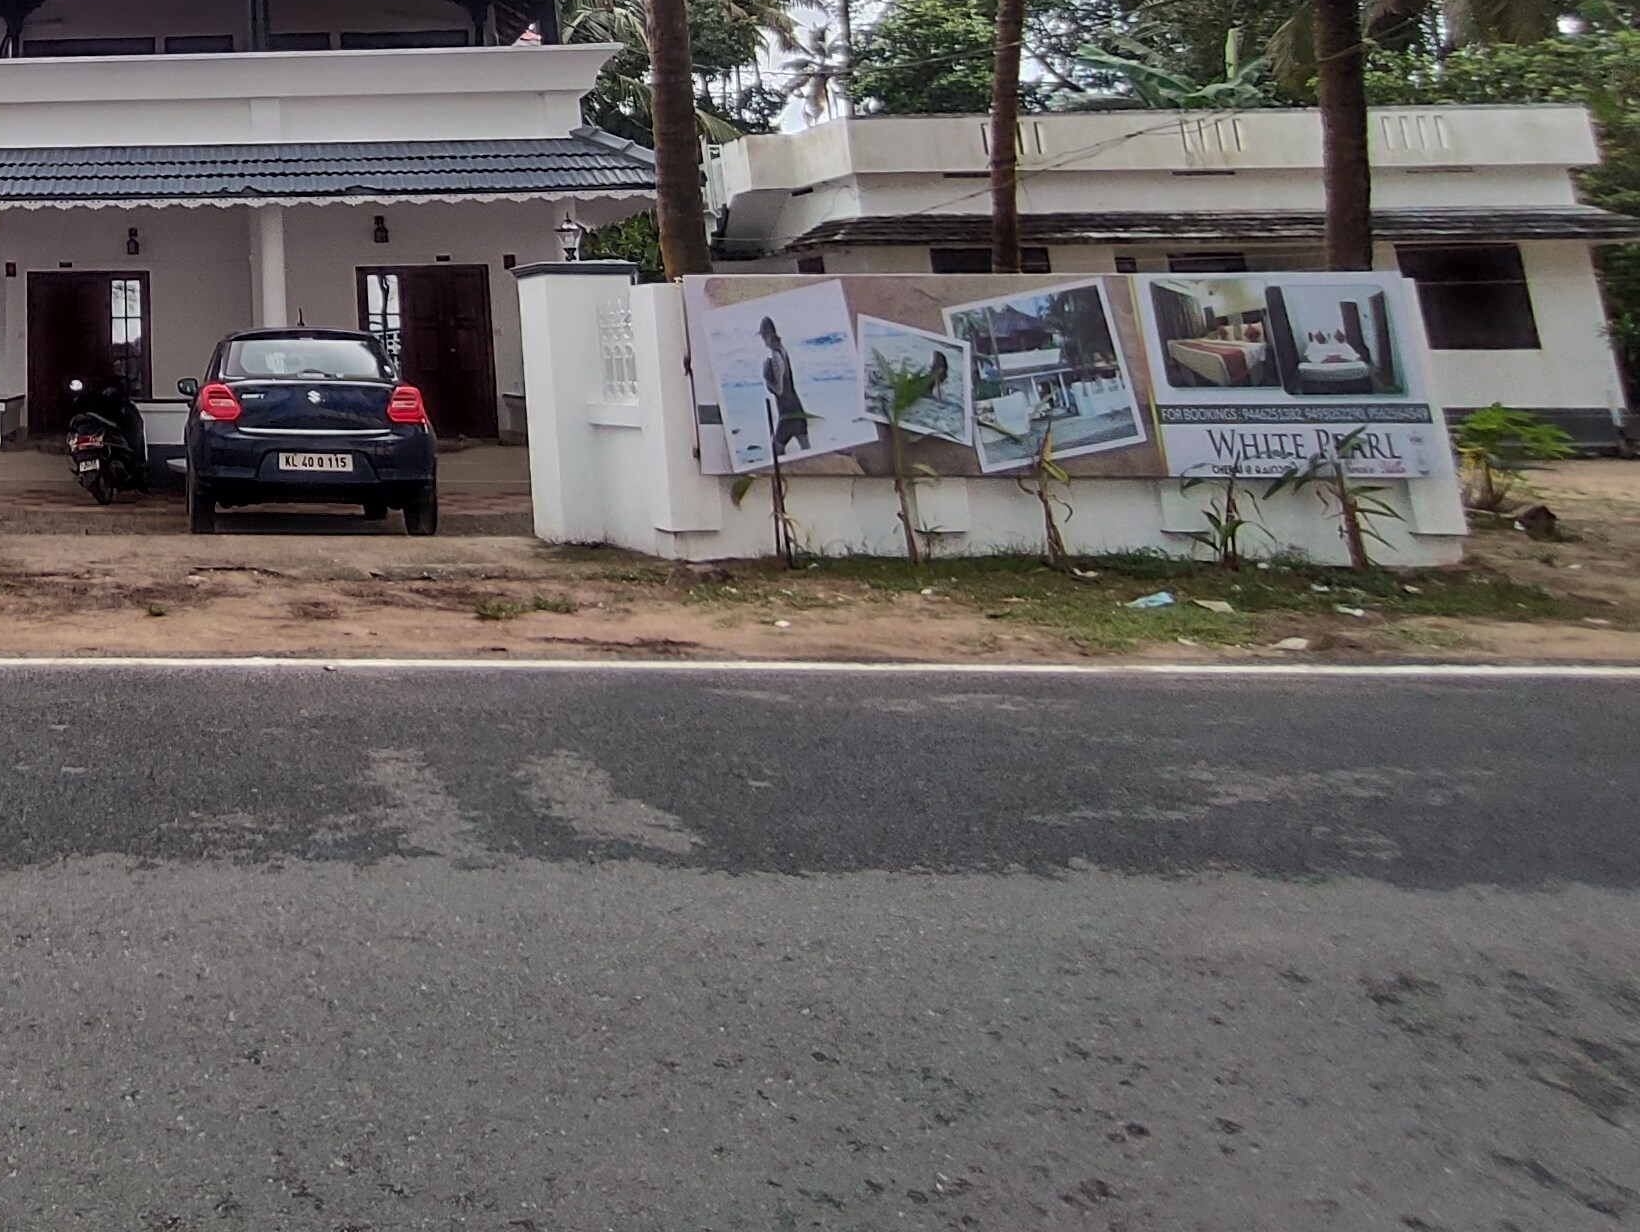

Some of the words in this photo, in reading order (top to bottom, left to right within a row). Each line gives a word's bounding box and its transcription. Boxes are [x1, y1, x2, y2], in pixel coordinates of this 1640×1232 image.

[1161, 409, 1183, 421] FOR
[1205, 429, 1308, 460] WHITE
[285, 456, 298, 467] KL
[302, 456, 314, 468] 40
[328, 456, 347, 469] 115
